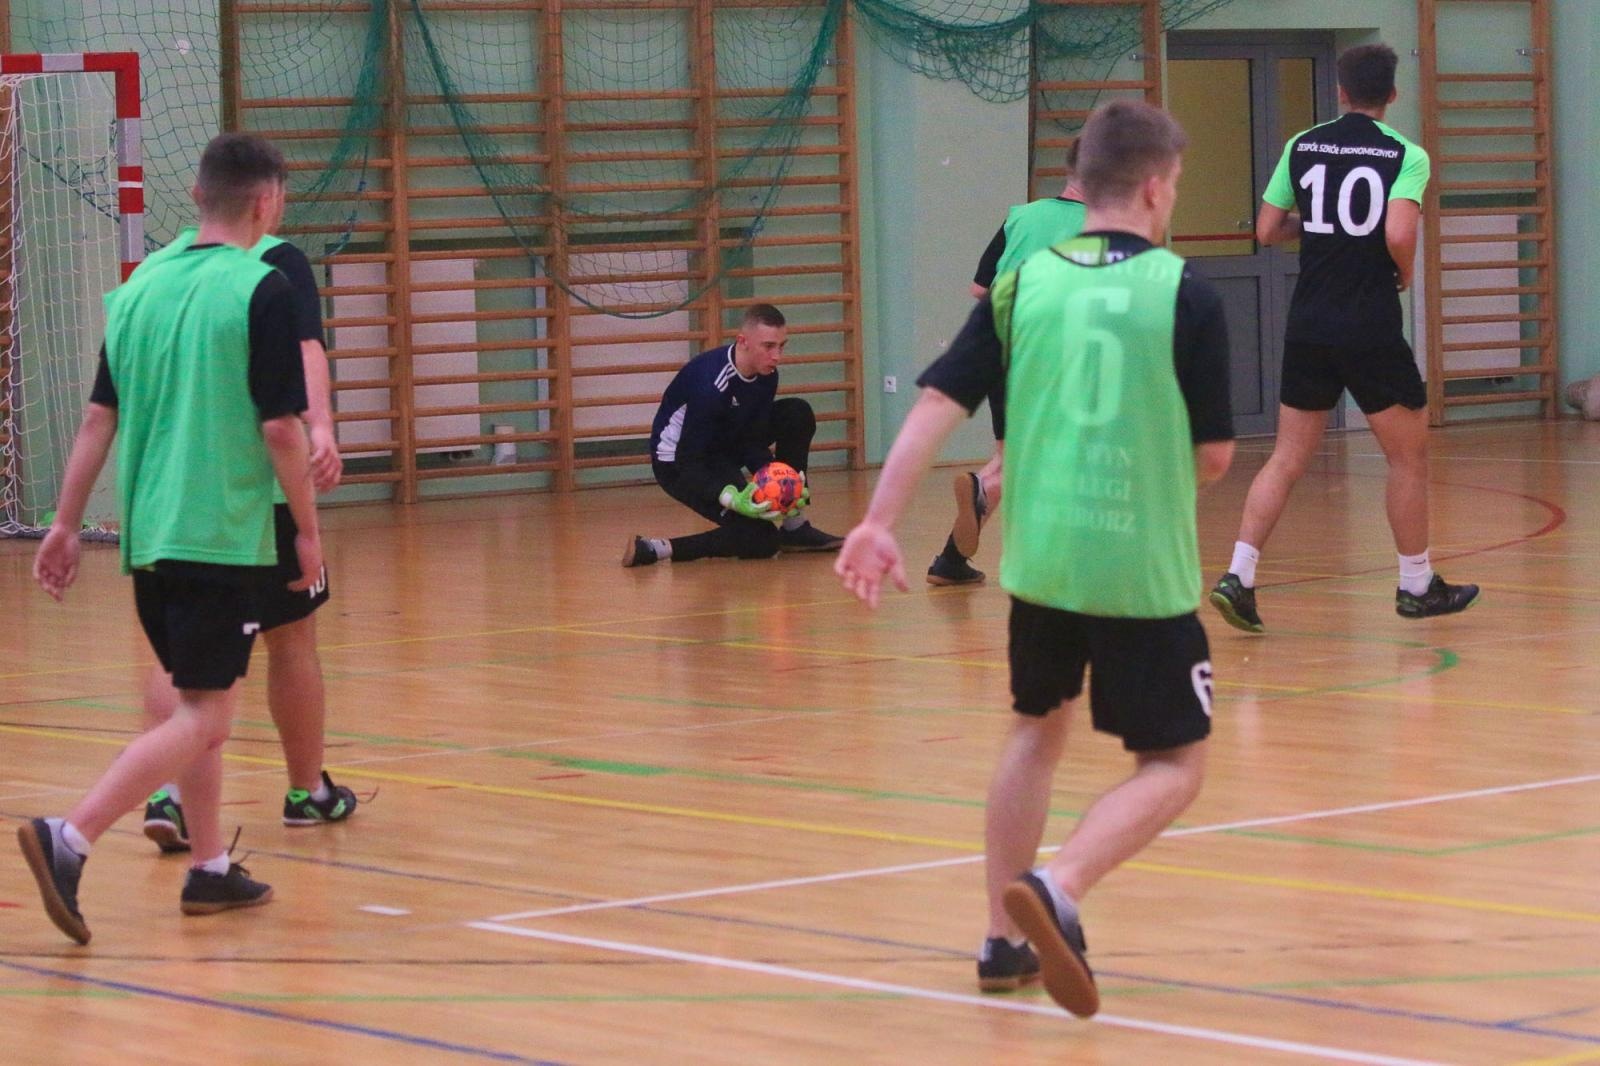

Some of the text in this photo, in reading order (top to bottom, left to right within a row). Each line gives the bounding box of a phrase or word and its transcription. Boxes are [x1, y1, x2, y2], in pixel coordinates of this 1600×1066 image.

[1340, 147, 1398, 159] EKONOMICZNYCH
[1299, 163, 1385, 237] 10
[1059, 286, 1131, 427] 6
[1191, 660, 1212, 717] 6
